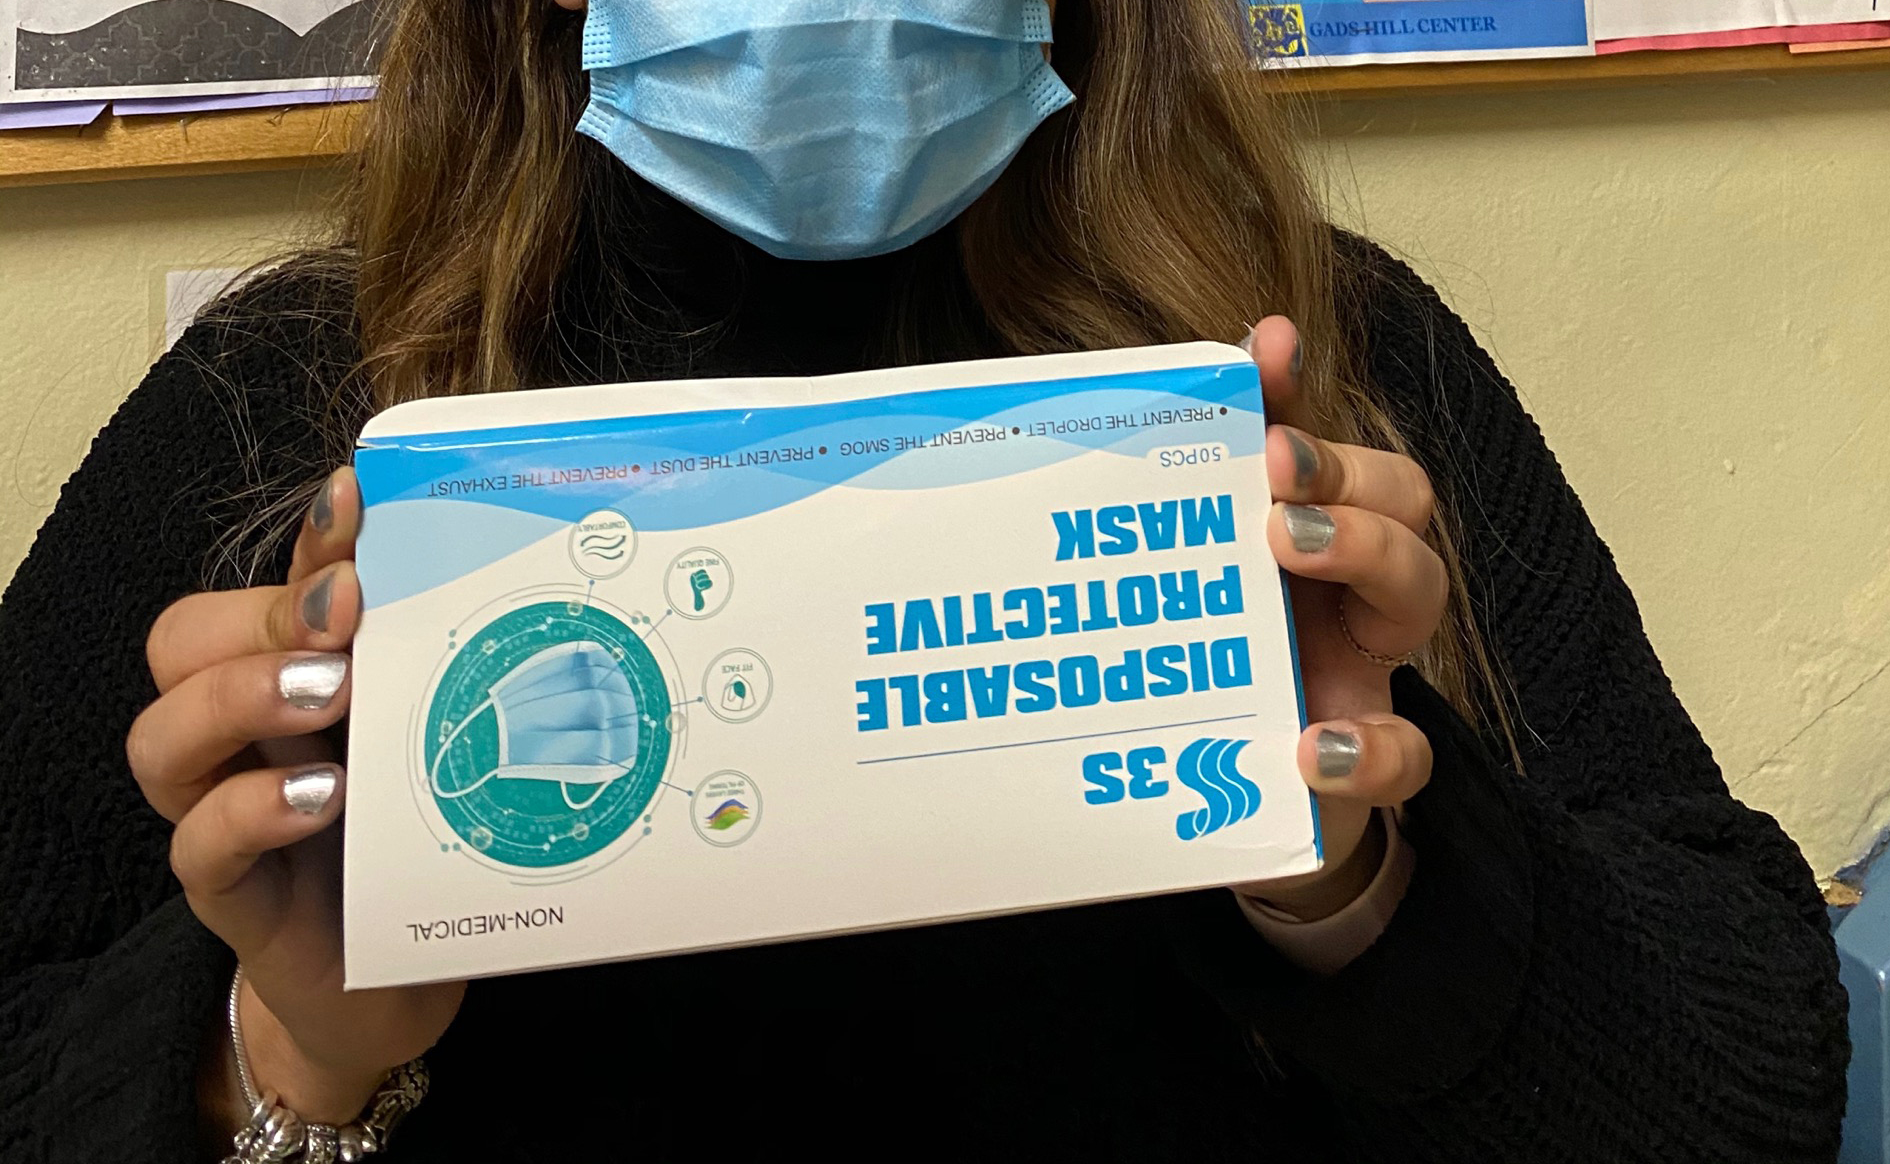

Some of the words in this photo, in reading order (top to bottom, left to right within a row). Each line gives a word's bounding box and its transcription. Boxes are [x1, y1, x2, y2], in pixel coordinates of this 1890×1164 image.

[1309, 21, 1359, 37] GADS
[1364, 19, 1415, 36] HILL
[1417, 16, 1497, 34] CENTER
[1027, 417, 1101, 436] DROPLET
[1105, 414, 1138, 429] THE
[1141, 407, 1213, 426] PREVENT
[894, 436, 926, 451] THE
[930, 427, 1006, 447] PREVENT
[736, 446, 814, 467] PREVENT
[840, 439, 890, 456] SMOG
[1160, 447, 1220, 467] 50PCS
[650, 458, 695, 475] DUST
[699, 455, 733, 470] THE
[512, 473, 545, 488] THE
[548, 465, 627, 484] PREVENT
[427, 476, 508, 496] EXHAUST
[1051, 494, 1236, 561] MASK
[865, 565, 1244, 655] PROTECTIVE
[856, 636, 1252, 732] DISPOSABLE
[1082, 746, 1169, 805] 3S
[406, 906, 563, 942] NON-MEDICAL
